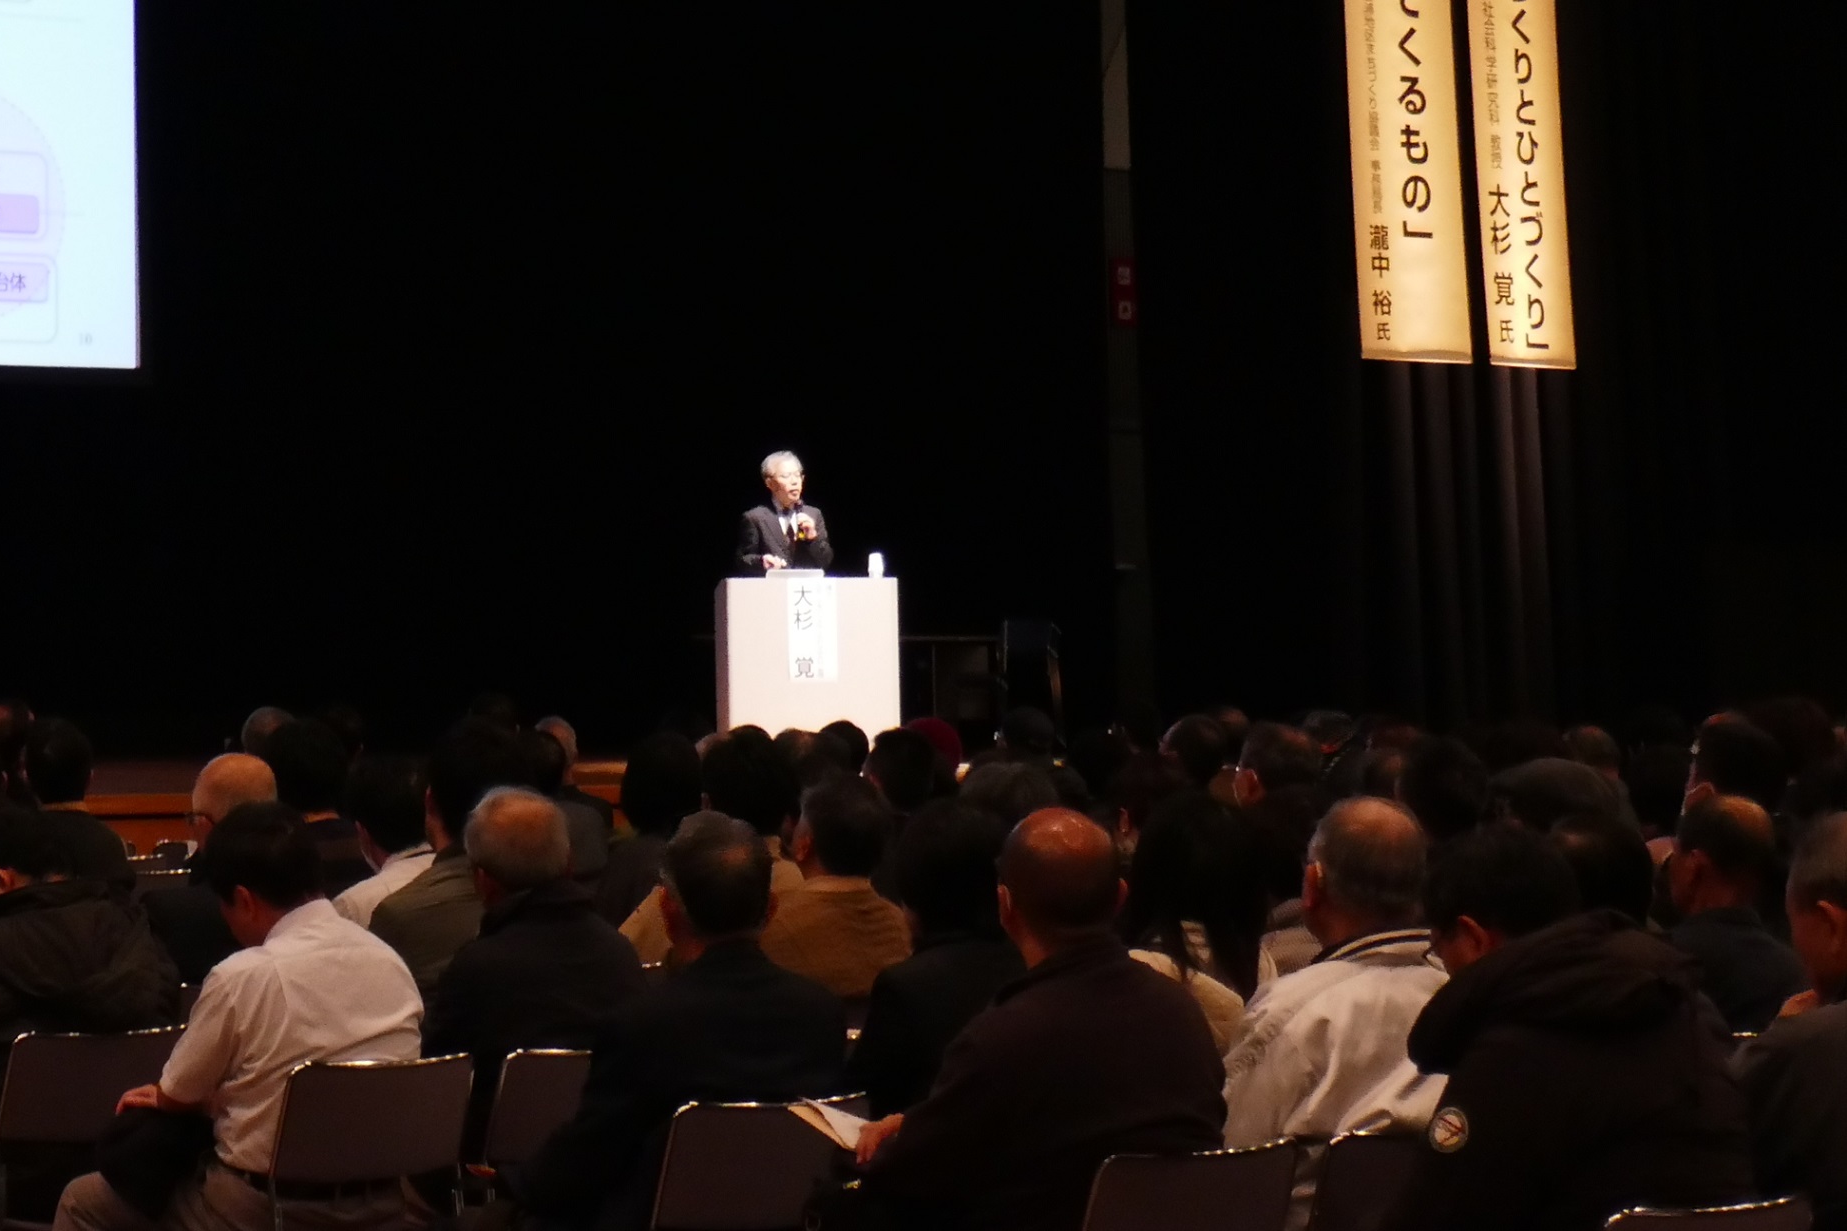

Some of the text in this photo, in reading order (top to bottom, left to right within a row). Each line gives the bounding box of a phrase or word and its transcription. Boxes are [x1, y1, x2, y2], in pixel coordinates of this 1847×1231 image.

[1488, 183, 1512, 255] 大杉
[1494, 271, 1514, 306] 覚
[1377, 322, 1391, 341] 氏
[1499, 320, 1514, 344] 氏
[793, 585, 814, 630] 大杉
